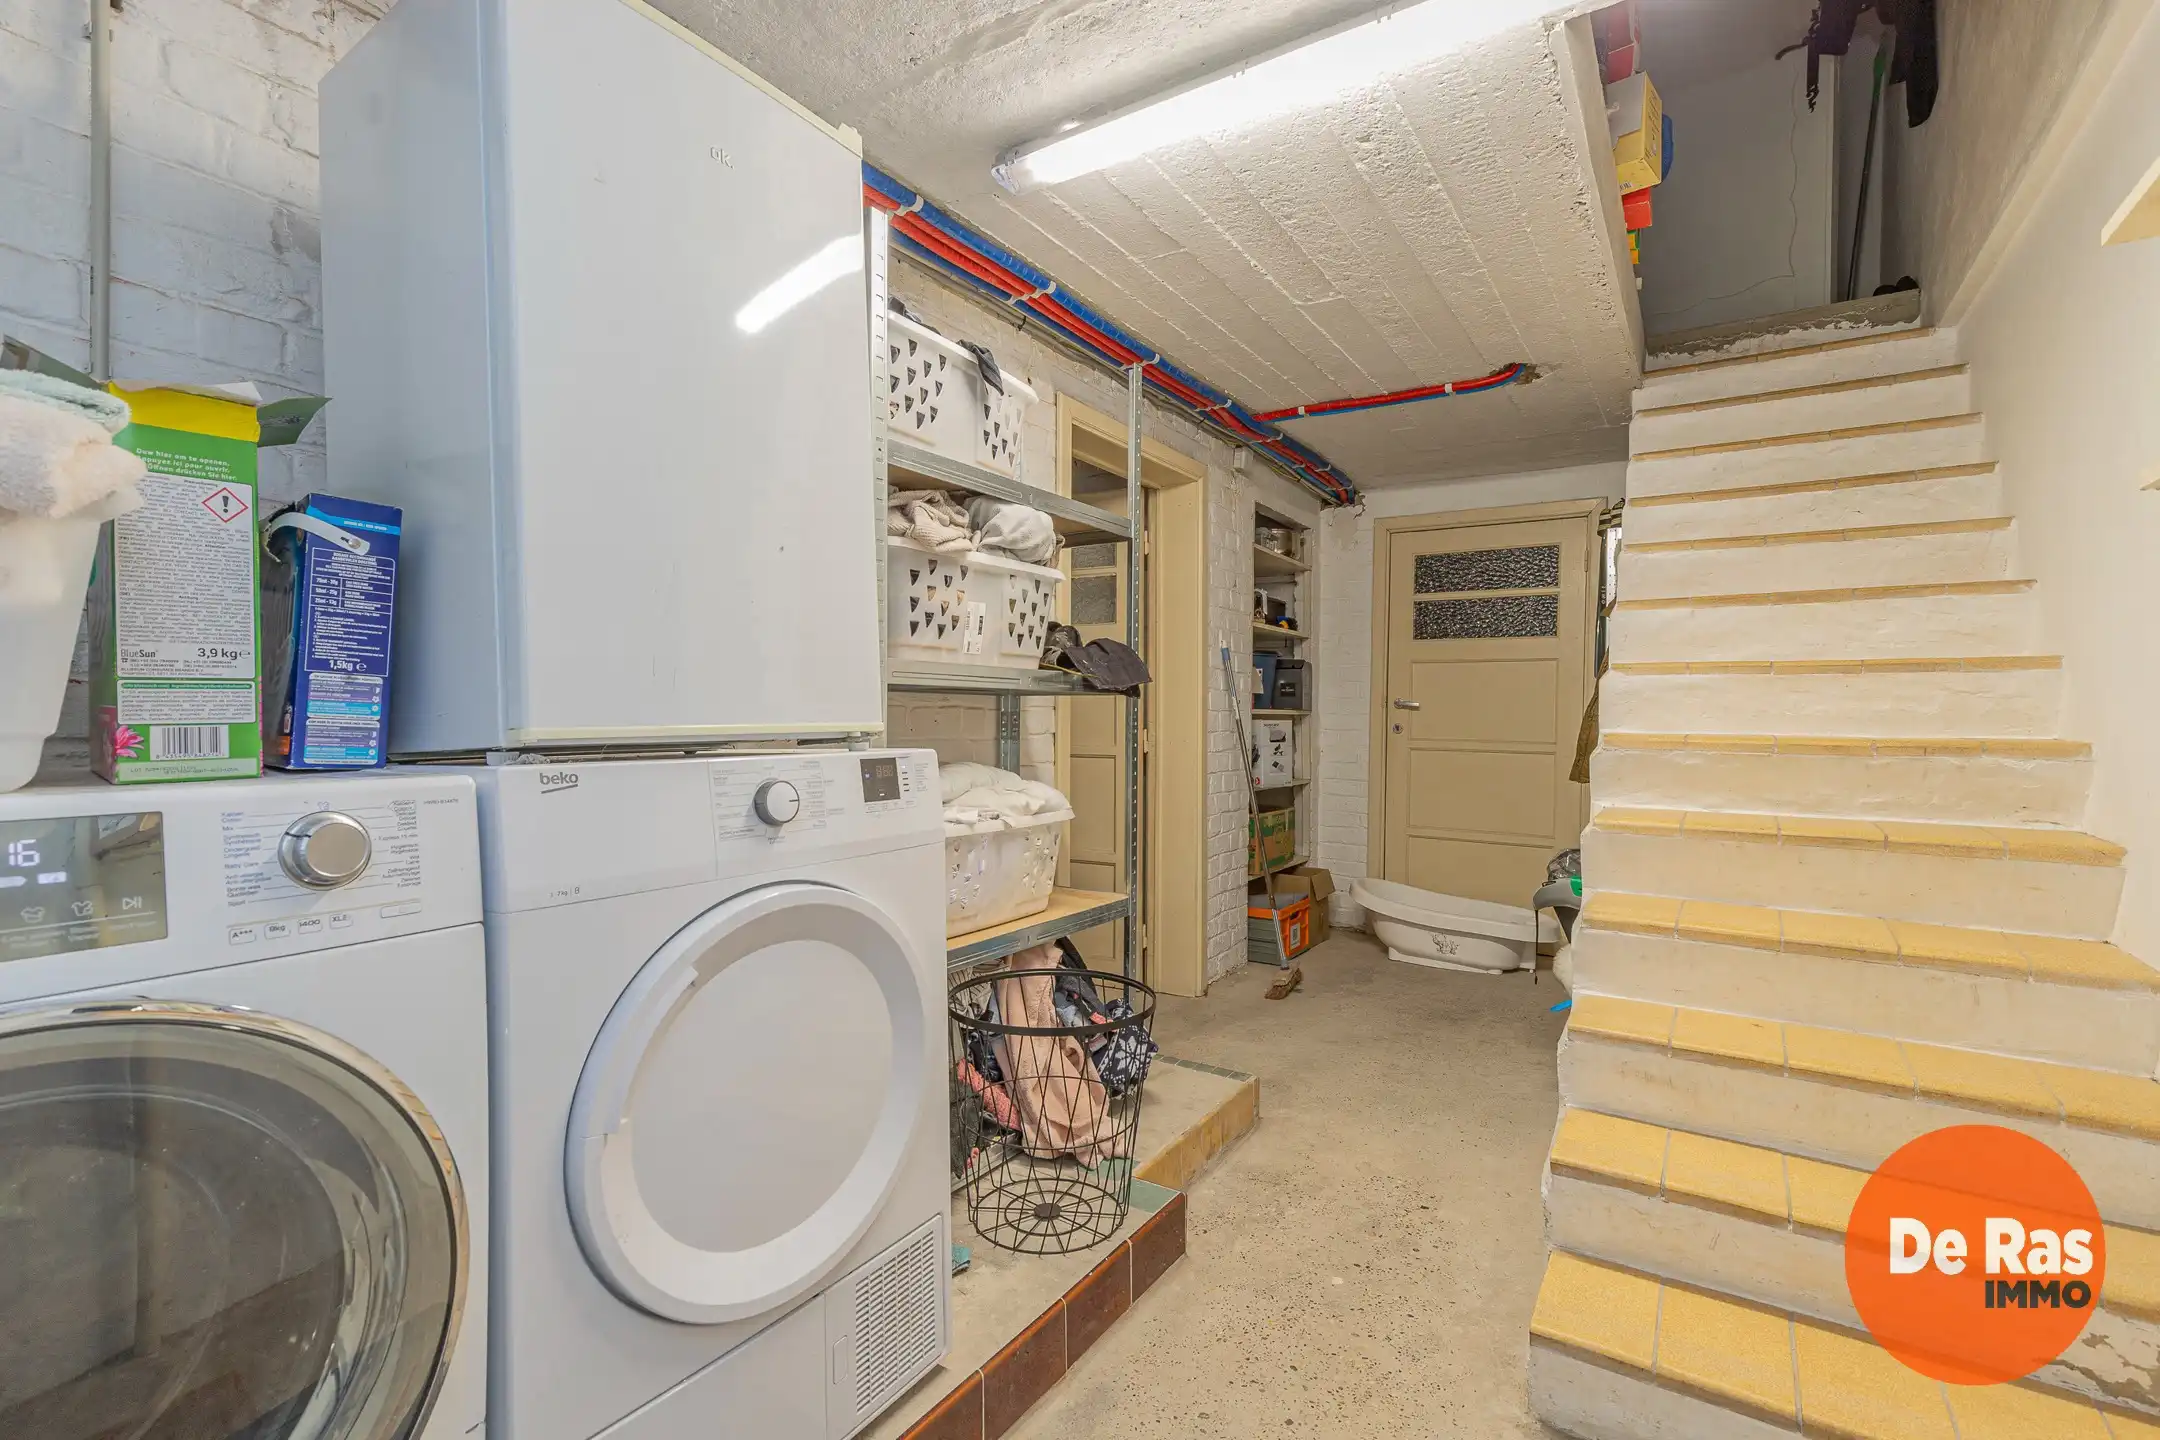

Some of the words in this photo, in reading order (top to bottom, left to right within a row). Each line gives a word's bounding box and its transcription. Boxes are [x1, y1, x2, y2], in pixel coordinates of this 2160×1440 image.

[136, 448, 153, 456] Duw
[156, 450, 172, 458] hier
[185, 462, 203, 470] pour
[175, 467, 206, 477] drücken
[208, 471, 219, 479] Sie
[197, 648, 218, 659] 3,9
[221, 648, 238, 660] kg
[329, 660, 353, 671] 1,5kg
[540, 771, 579, 785] beko
